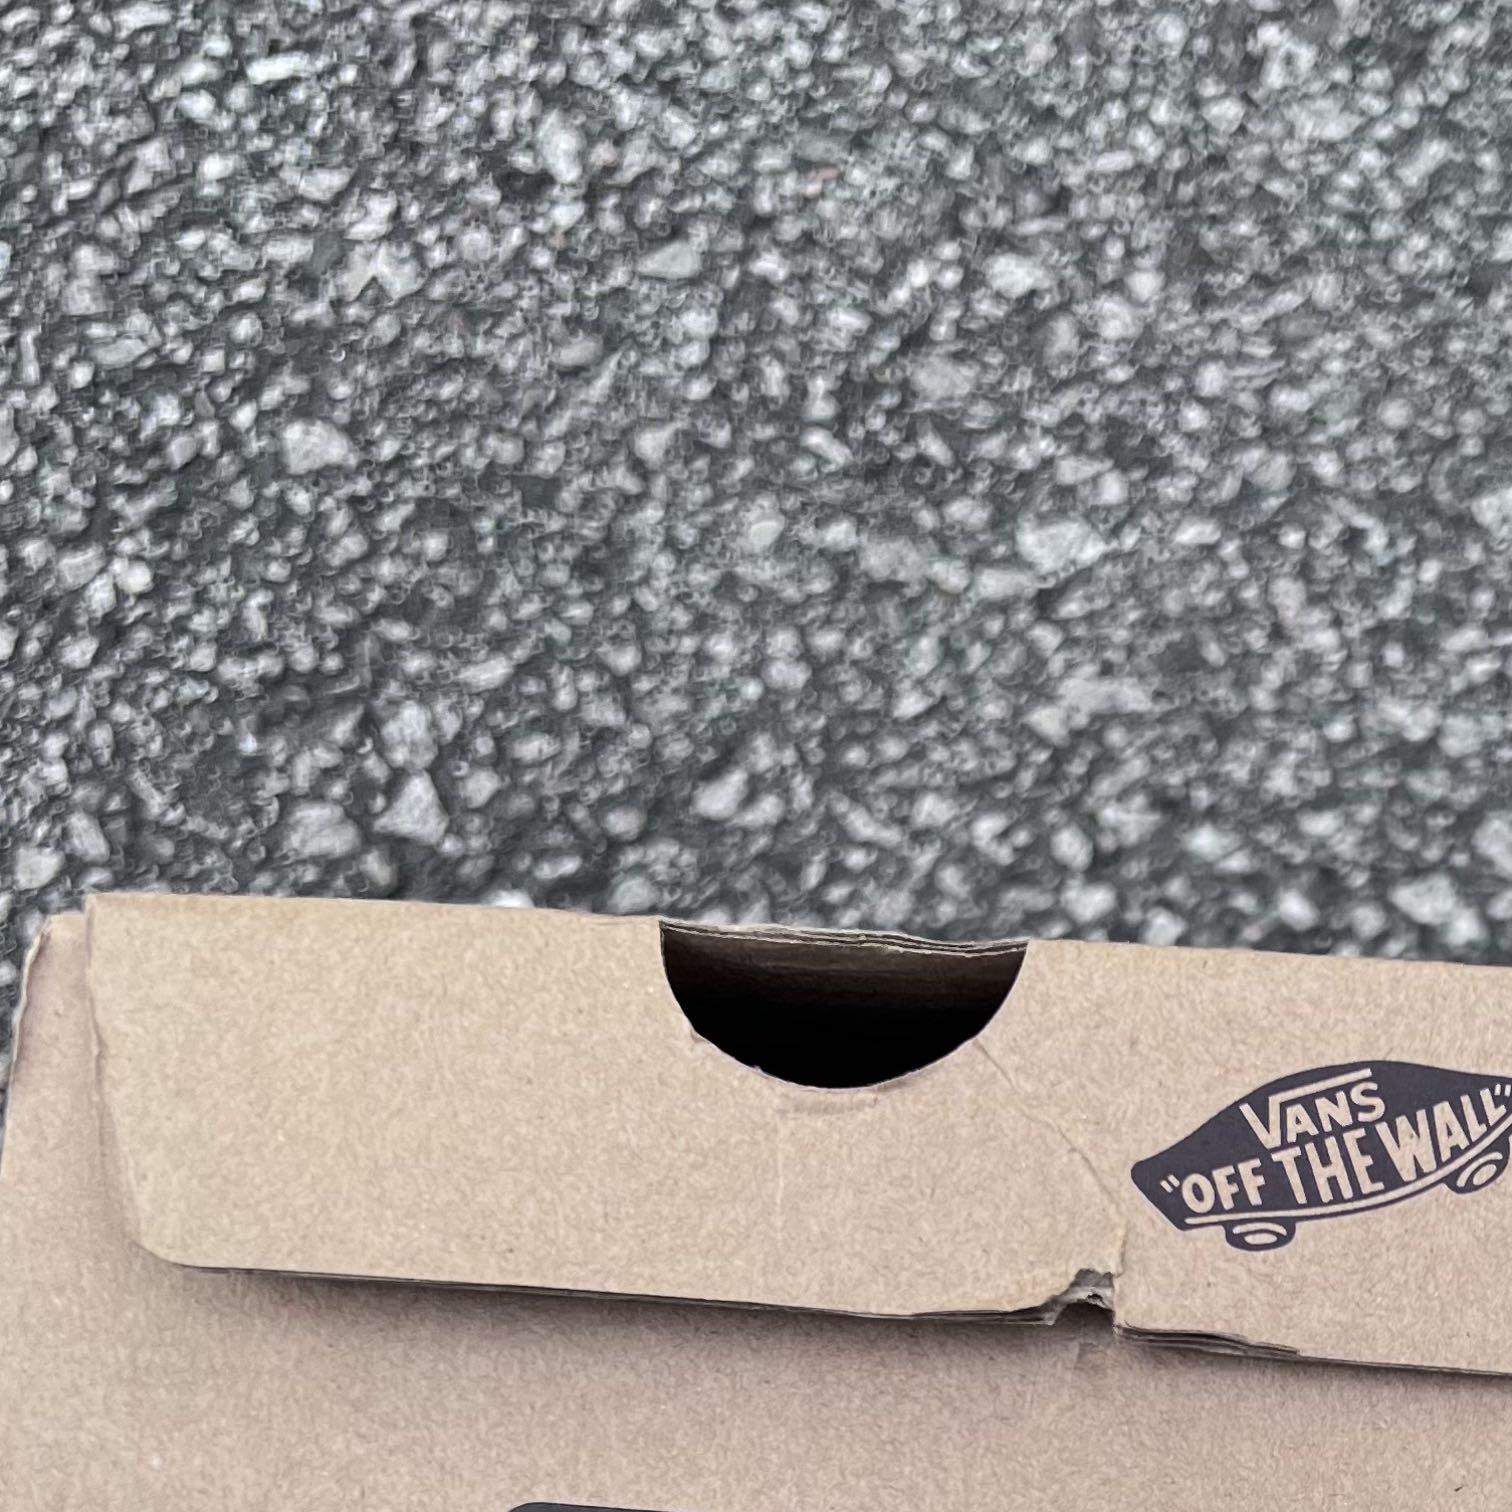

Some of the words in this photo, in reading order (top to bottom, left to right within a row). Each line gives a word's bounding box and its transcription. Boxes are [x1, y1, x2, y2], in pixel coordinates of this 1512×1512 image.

[1160, 1157, 1265, 1213] "OFF
[1272, 1127, 1384, 1205] THE
[1376, 1083, 1512, 1182] WALL"
[1239, 1069, 1386, 1149] VANS
